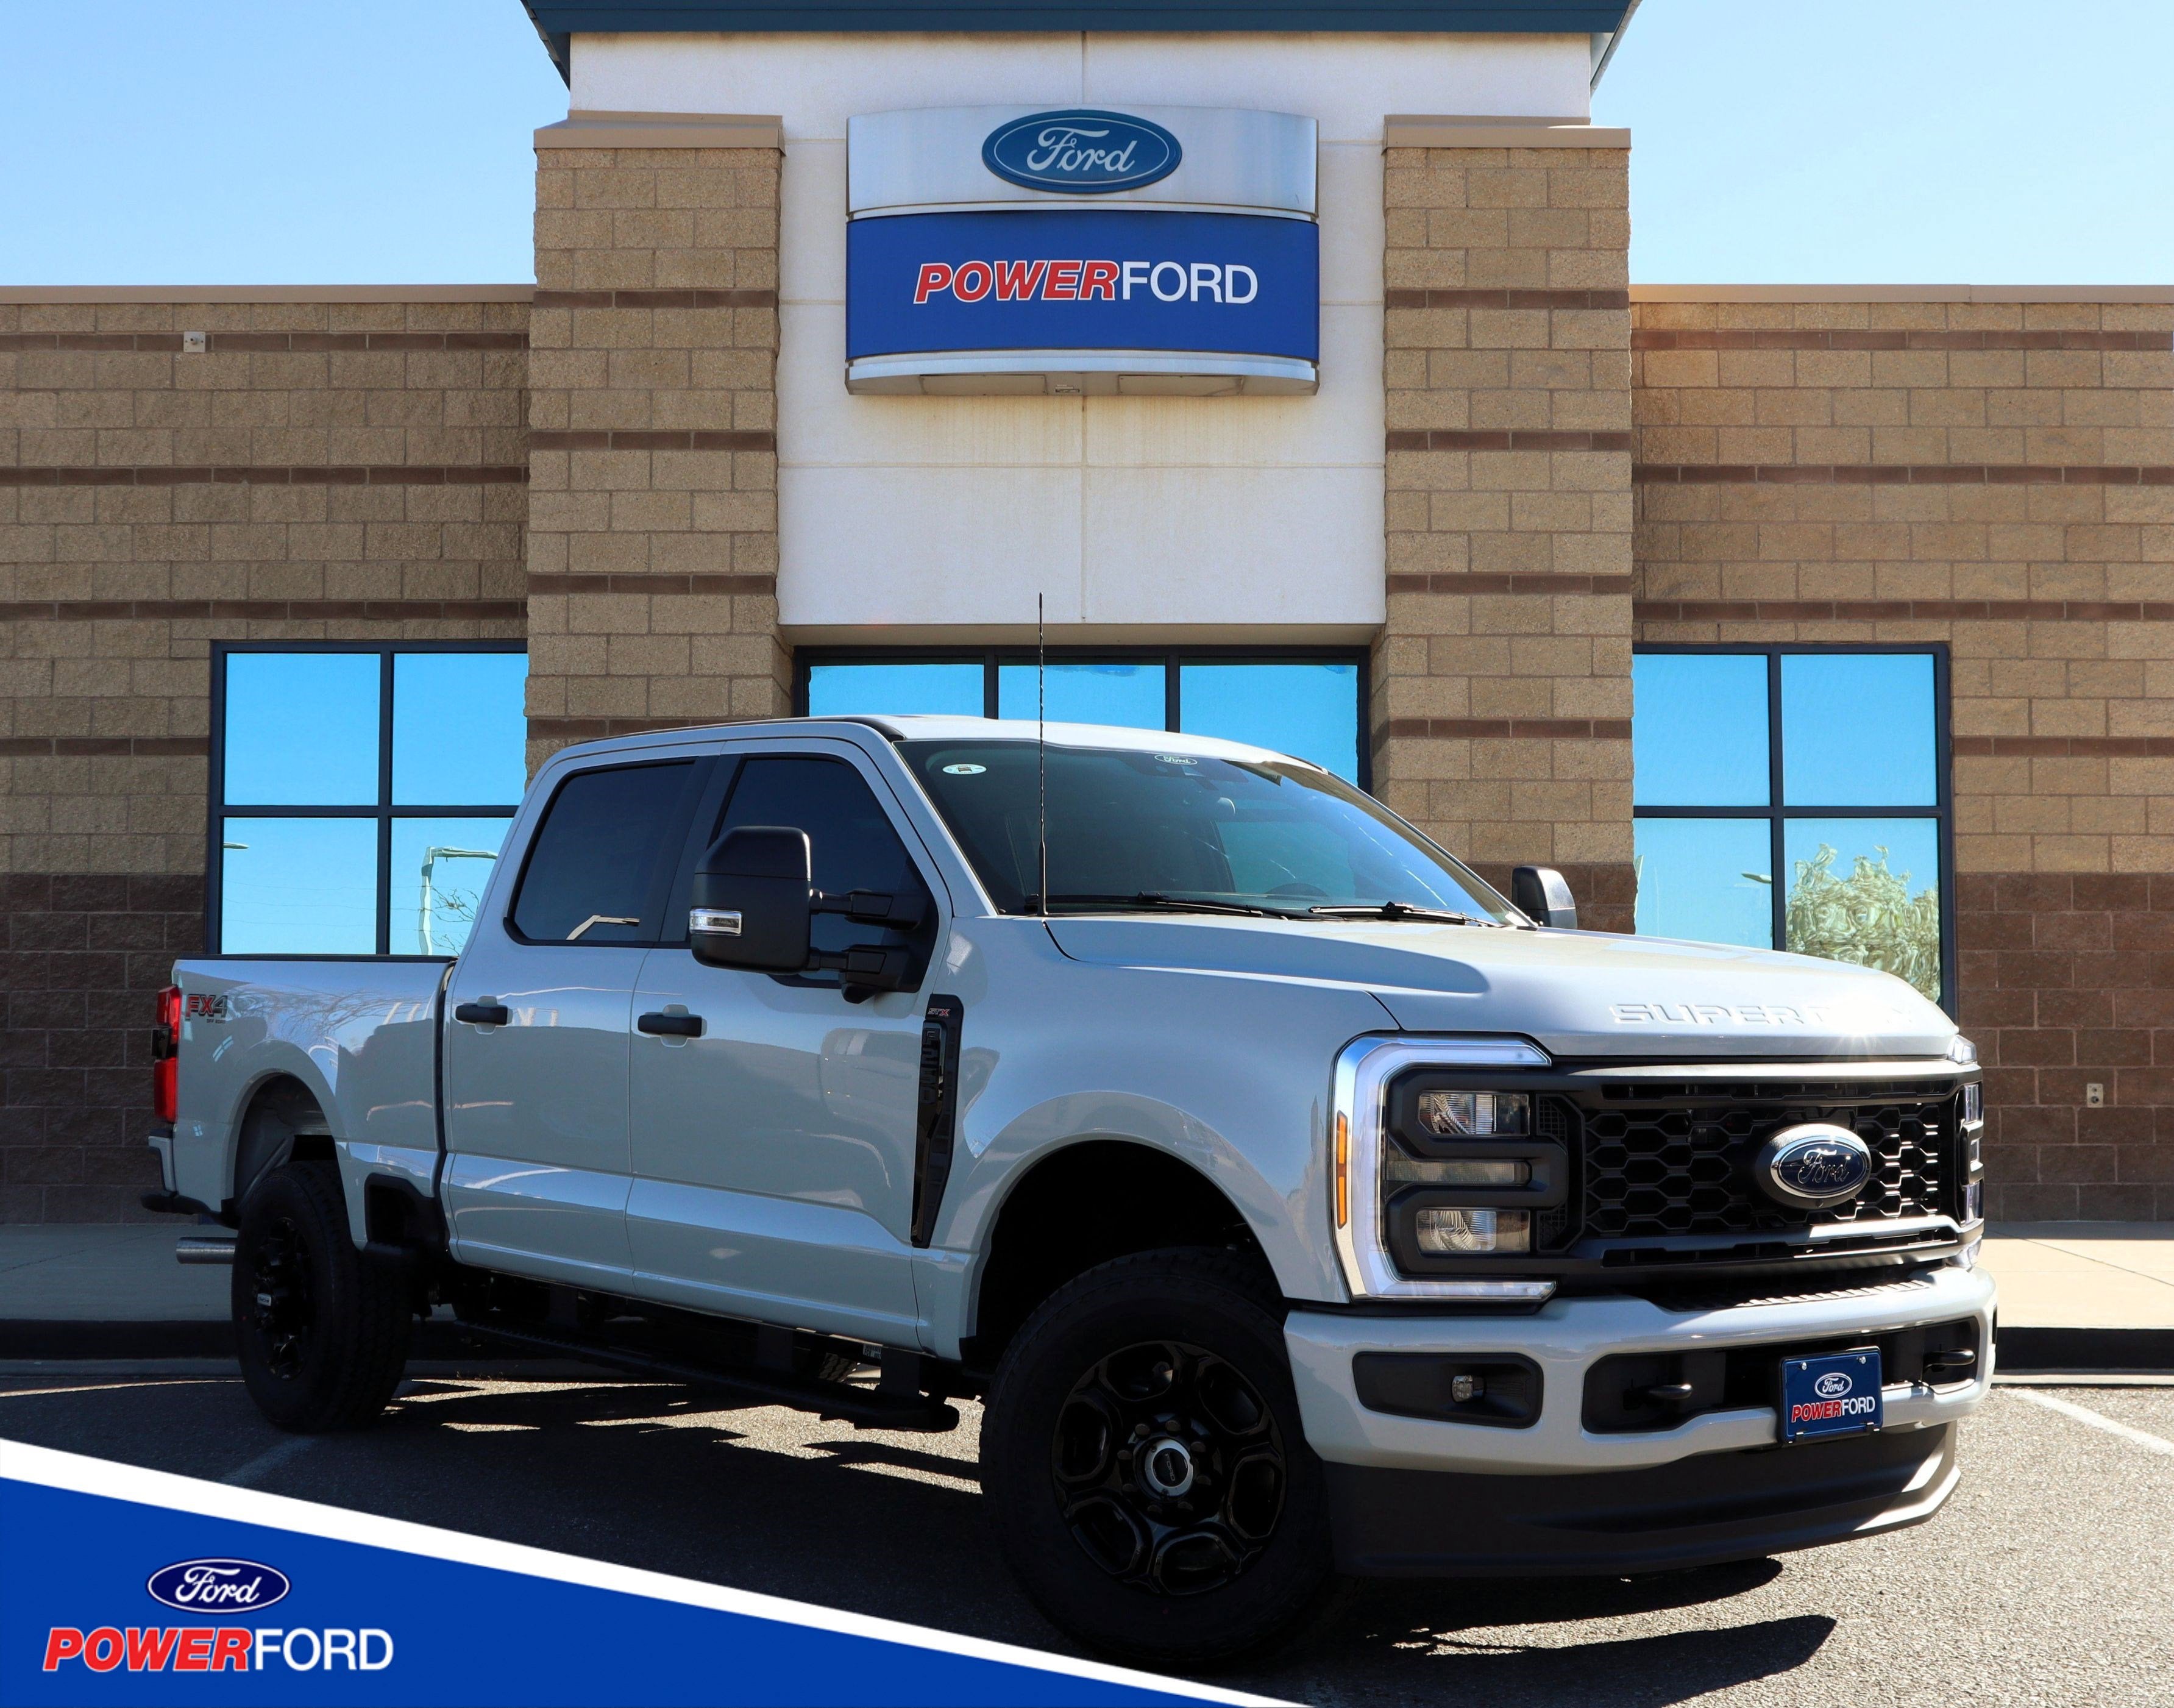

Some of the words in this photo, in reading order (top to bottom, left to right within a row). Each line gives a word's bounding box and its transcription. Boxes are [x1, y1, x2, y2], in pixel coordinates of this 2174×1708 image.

[1026, 127, 1137, 173] Ford
[913, 260, 1259, 304] POWERFORD
[185, 994, 228, 1020] FX4
[928, 1008, 951, 1016] STX
[1610, 1003, 1804, 1025] SUPER
[1798, 1148, 1849, 1184] Ford
[1822, 1378, 1844, 1393] Ford
[1791, 1397, 1876, 1423] POWERFORD
